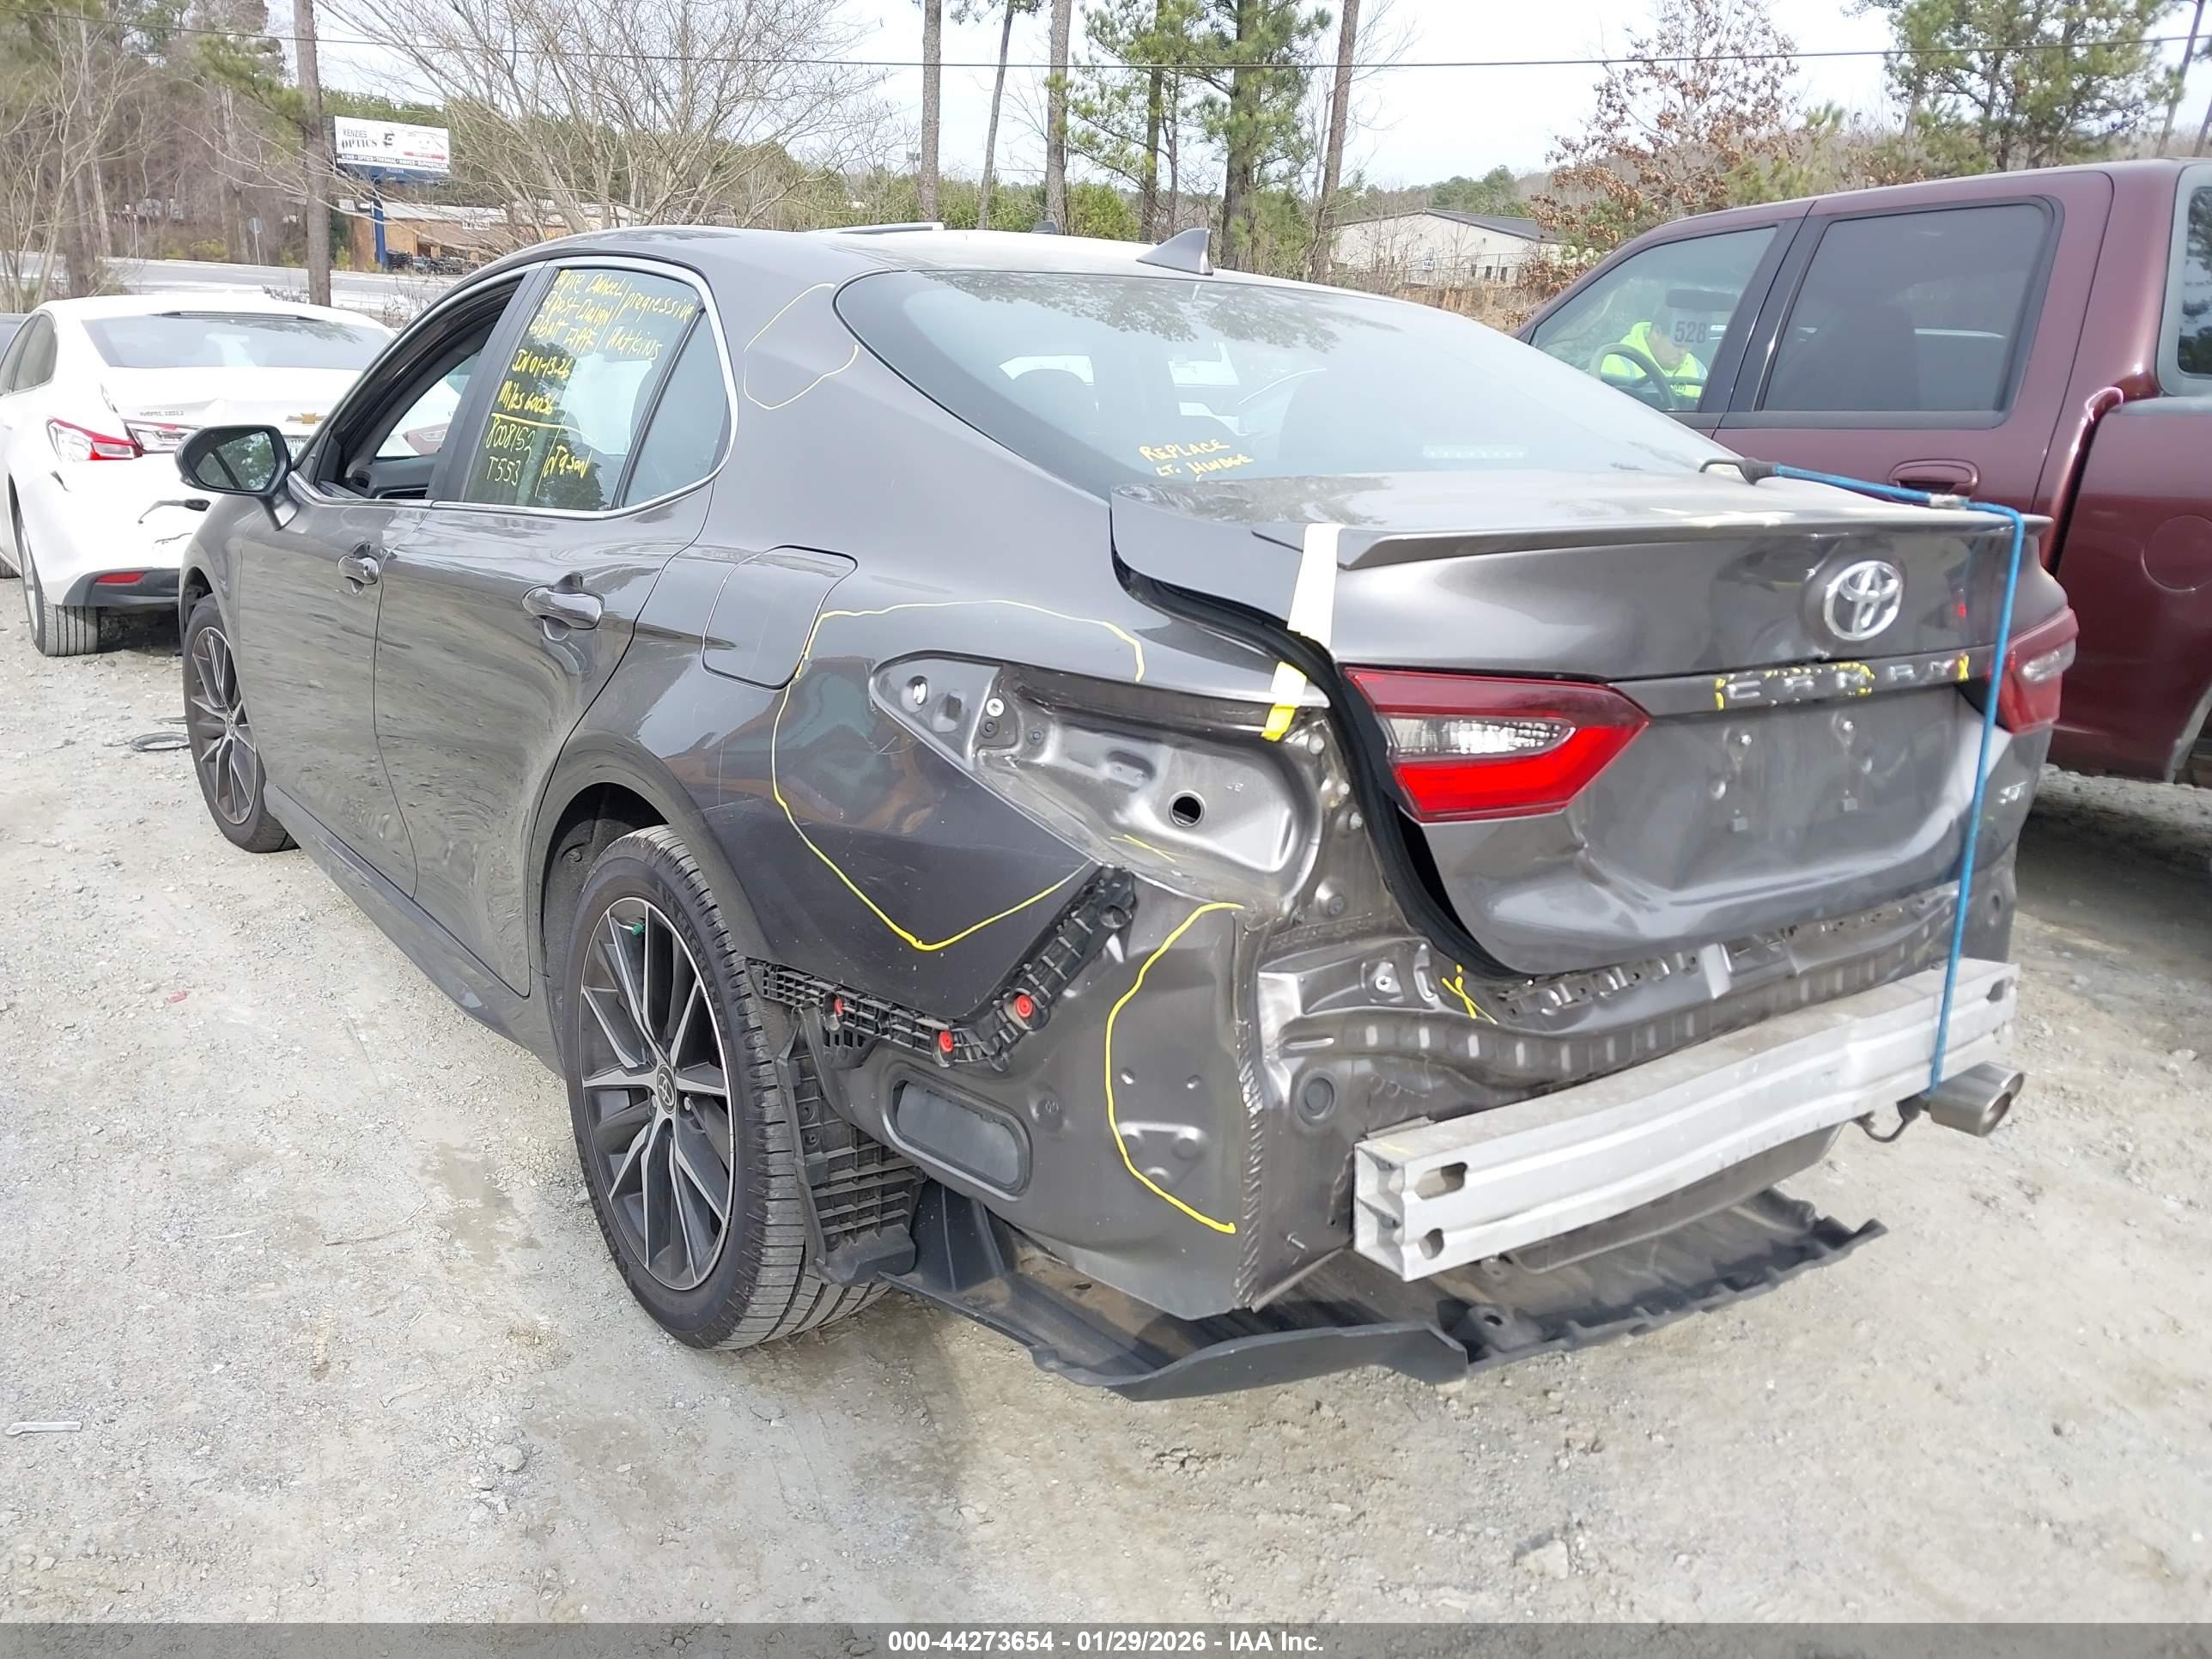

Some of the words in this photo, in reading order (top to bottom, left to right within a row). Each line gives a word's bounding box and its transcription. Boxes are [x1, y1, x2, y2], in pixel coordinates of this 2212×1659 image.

[341, 138, 378, 149] OPTICS
[343, 128, 368, 138] KENZIES
[1675, 321, 1707, 343] 528
[523, 391, 556, 416] 60036
[1139, 439, 1231, 462] REPLACE
